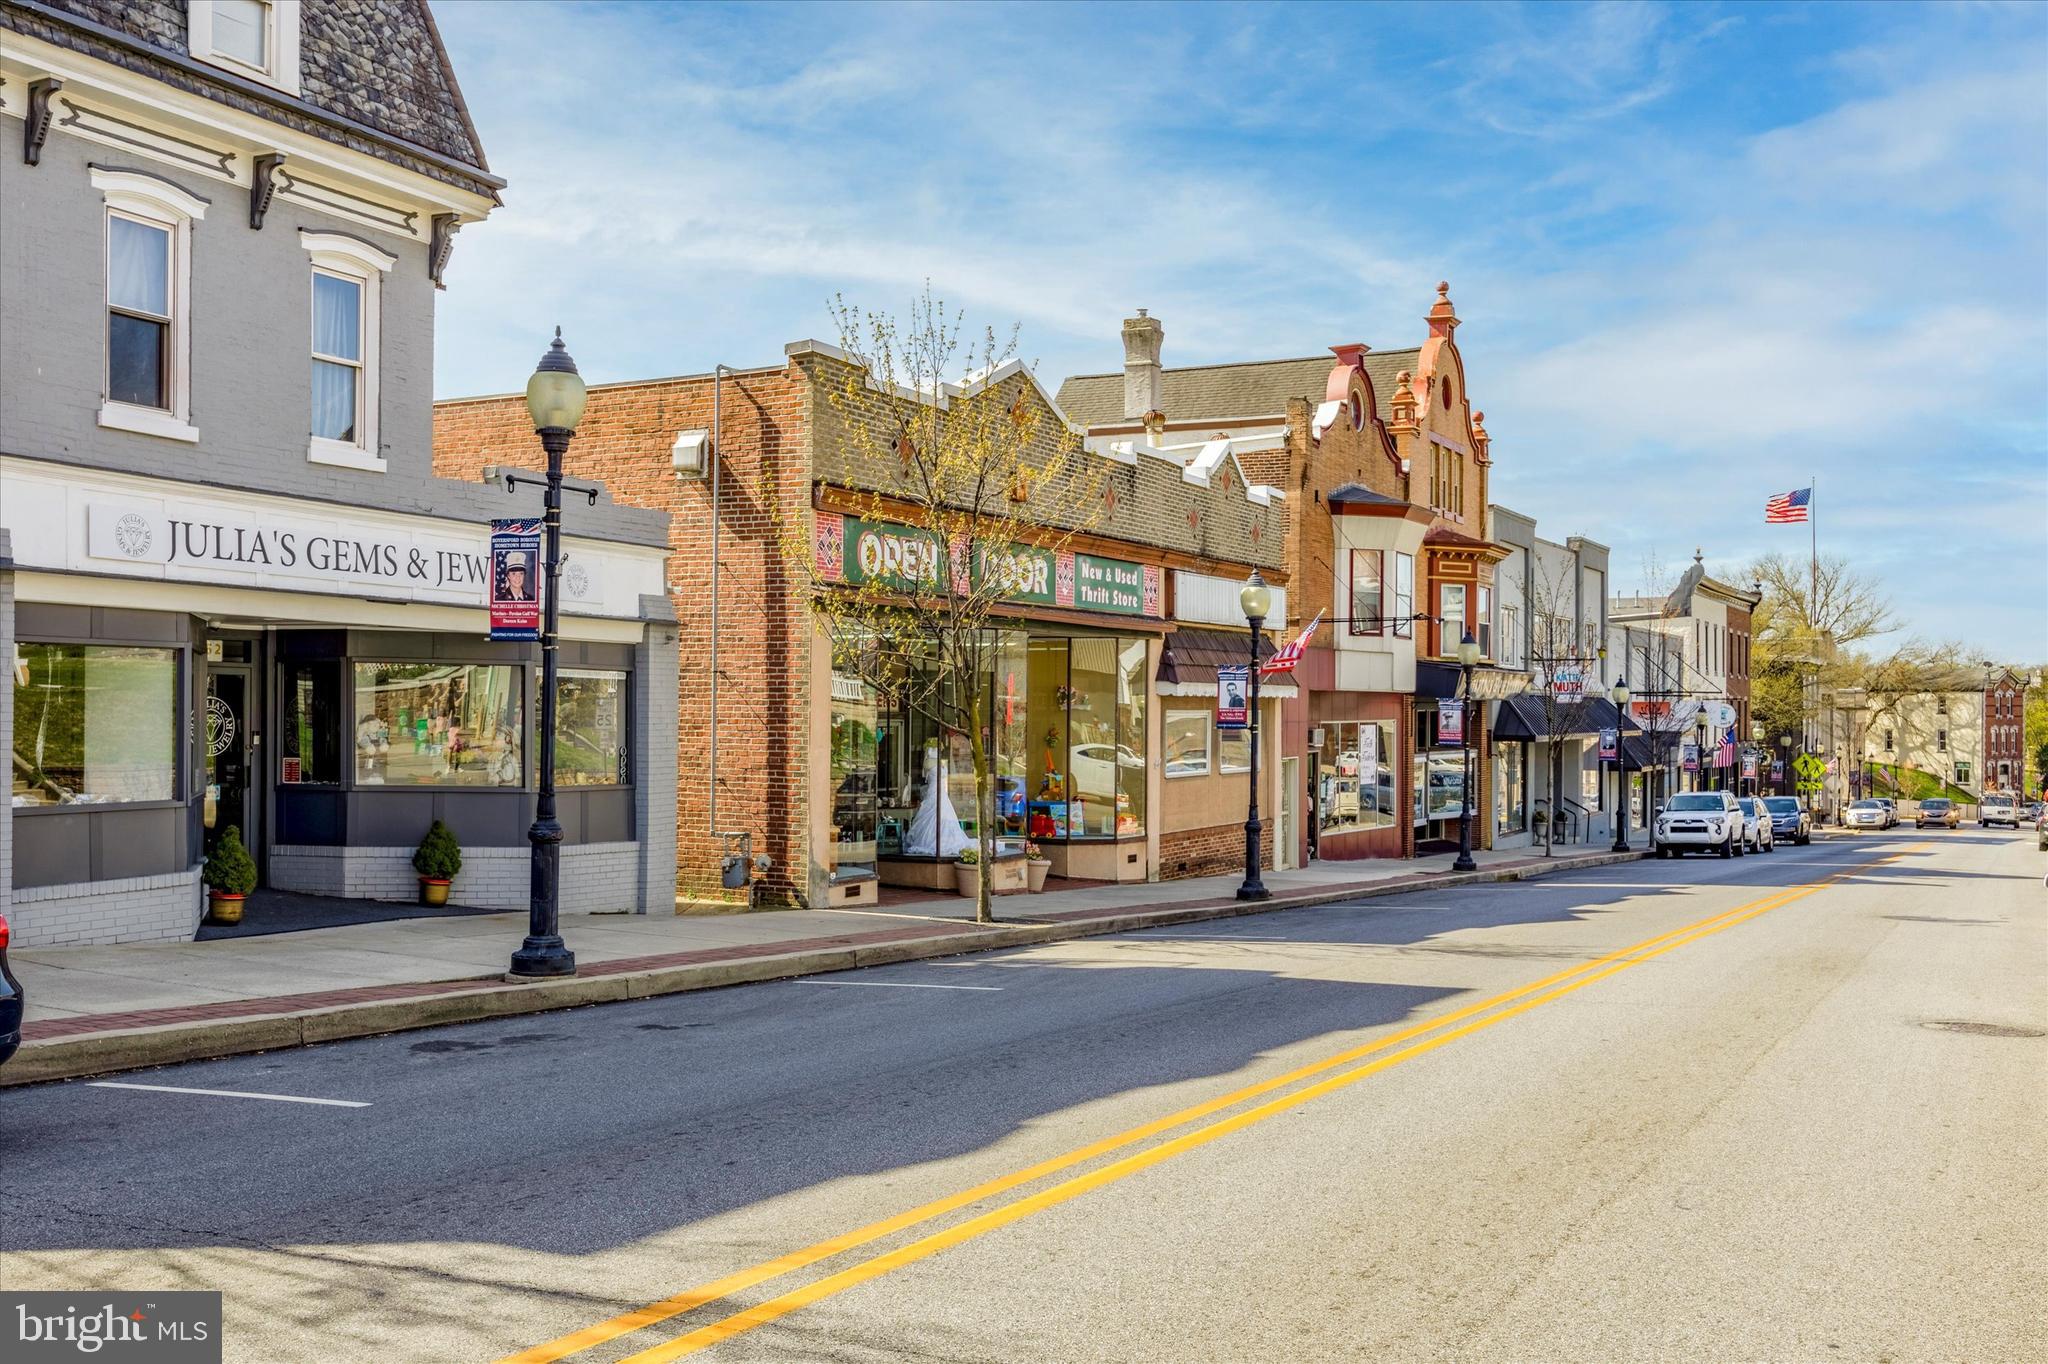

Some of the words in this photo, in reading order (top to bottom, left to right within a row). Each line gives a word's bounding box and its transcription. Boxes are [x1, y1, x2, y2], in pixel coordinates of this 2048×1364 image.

[167, 519, 297, 567] JULIA'S
[306, 537, 398, 577] GEMS
[407, 547, 429, 579] &
[859, 531, 938, 582] OPEN
[981, 548, 1049, 595] DOOR
[1081, 562, 1103, 581] New
[1105, 567, 1112, 582] &
[1115, 567, 1138, 586] Used
[1081, 585, 1109, 604] Thrift
[1112, 590, 1138, 608] Store
[1553, 682, 1583, 692] MUTH
[206, 699, 227, 714] LIA'S
[208, 717, 233, 756] JEWELRY
